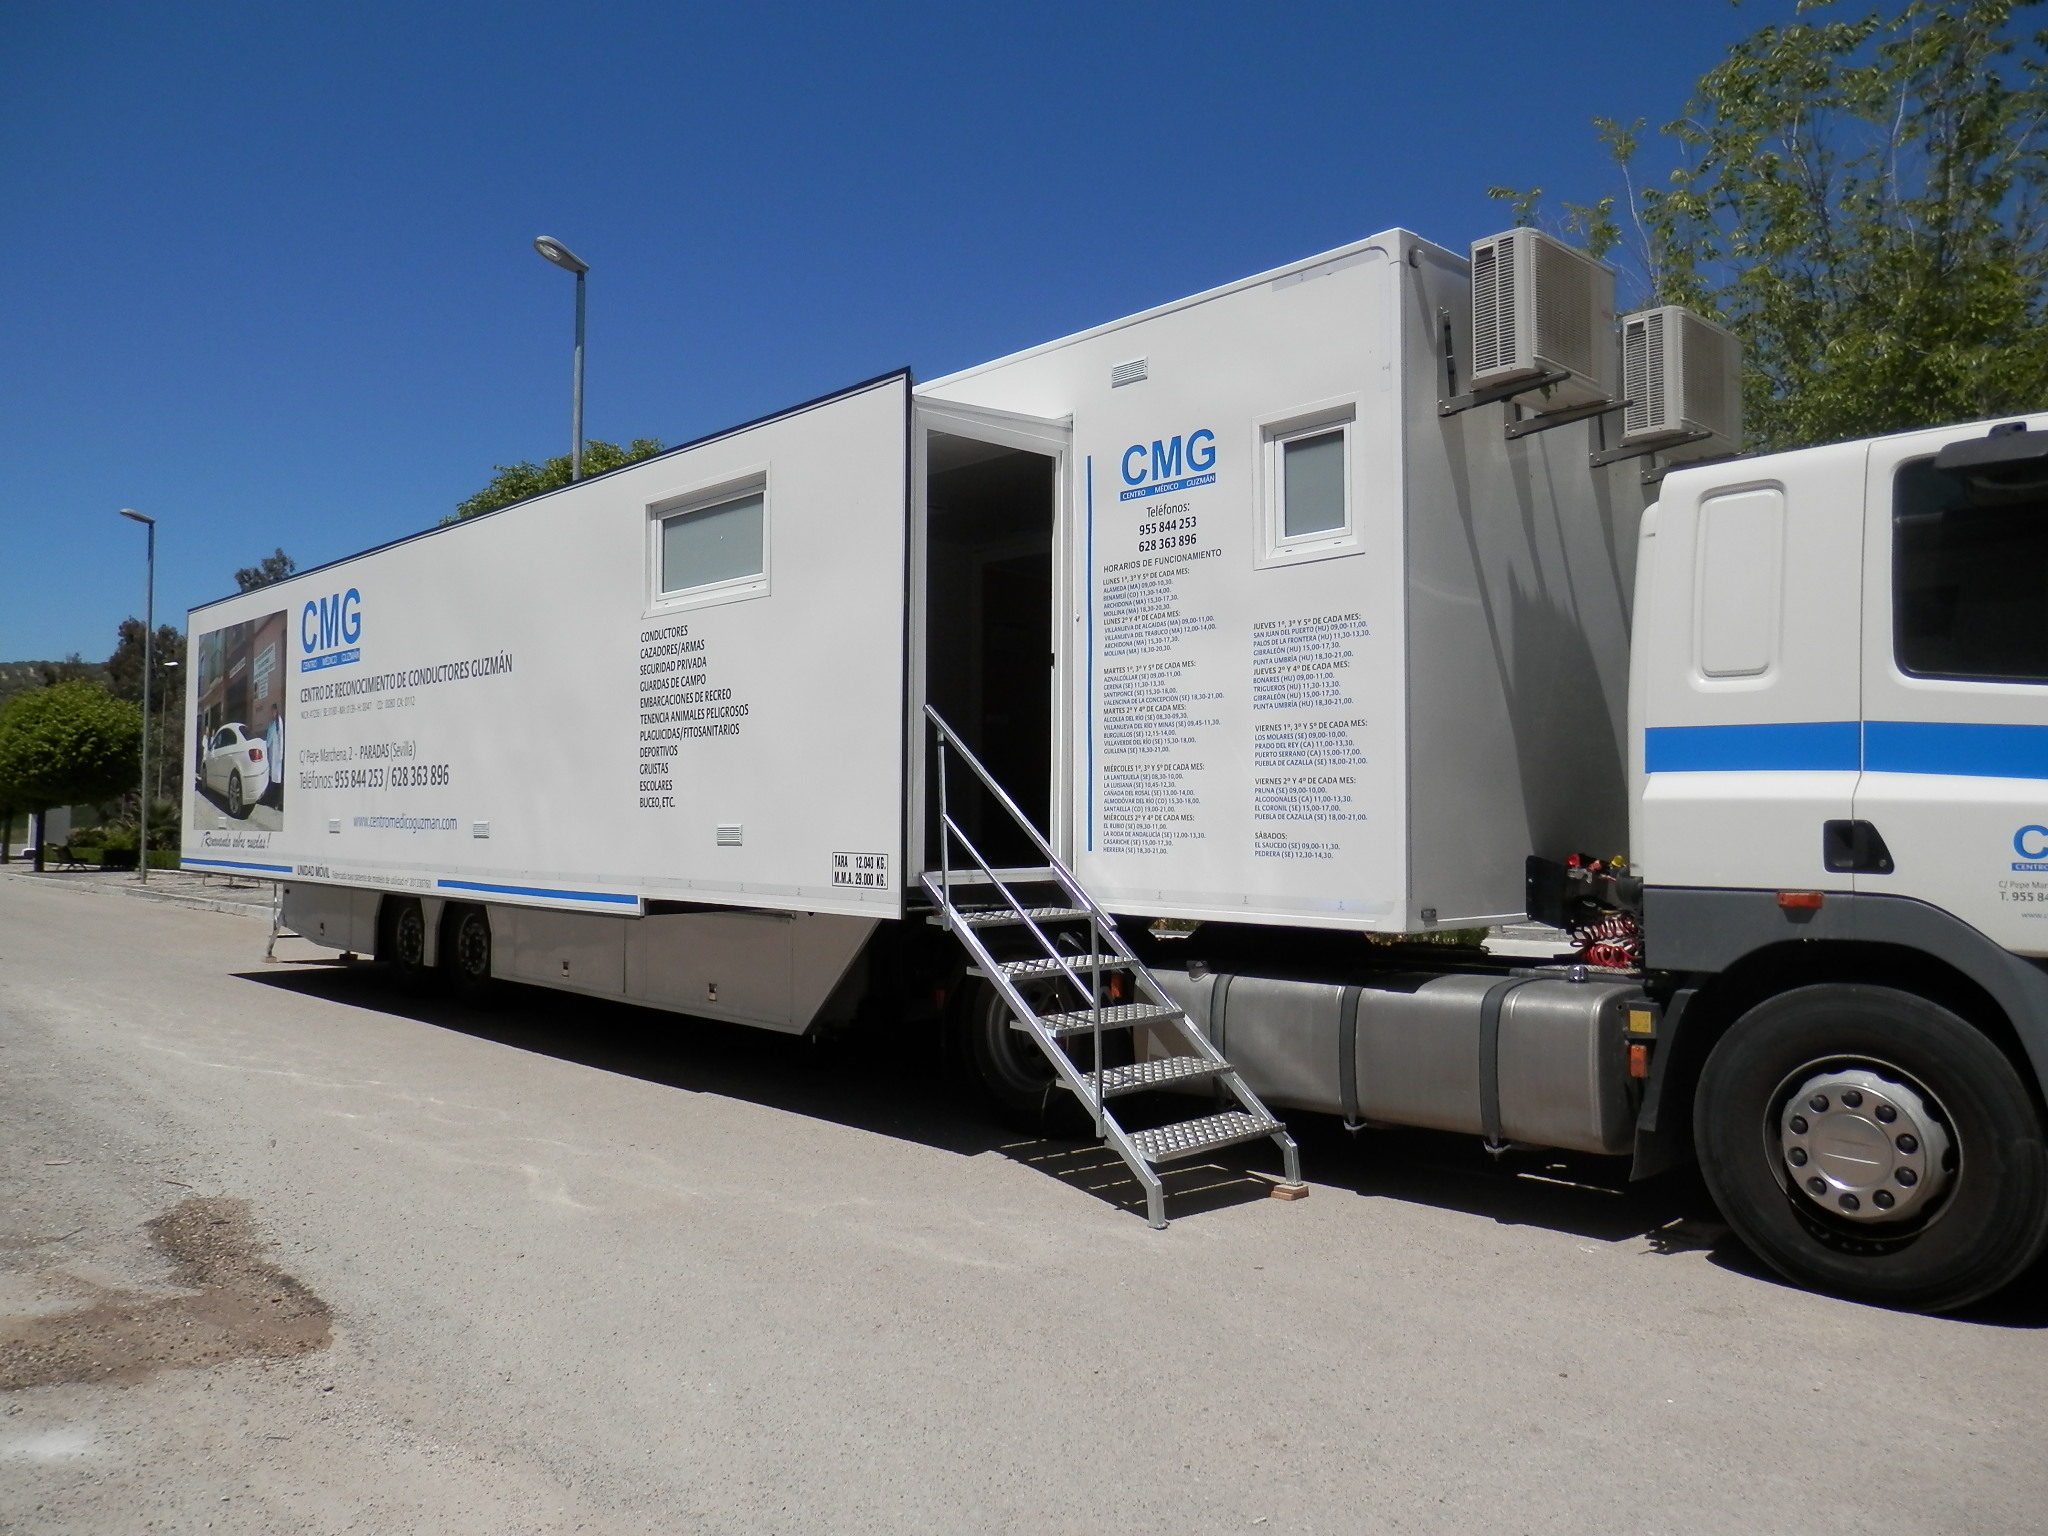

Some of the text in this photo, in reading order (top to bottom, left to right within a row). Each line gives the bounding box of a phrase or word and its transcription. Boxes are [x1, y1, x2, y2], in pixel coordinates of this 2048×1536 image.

[1122, 429, 1216, 485] CMG
[1123, 475, 1214, 499] CENTRO MÉDICO GUZMÁN
[1147, 503, 1190, 517] Teléfonos:
[1140, 516, 1196, 535] 955 844 253
[1139, 534, 1196, 552] 628 363 896
[1104, 549, 1221, 573] HORARIOS DE FUNCIONAMIENTO
[1104, 584, 1126, 593] ALAMEDA
[1128, 583, 1140, 591] (MA)
[302, 588, 360, 653] CMG
[1104, 609, 1125, 617] MOLLINA
[1254, 621, 1275, 630] JUEVES
[1323, 615, 1342, 623] CADA
[1292, 626, 1314, 634] PUERTO
[640, 625, 688, 642] CONDUCTORES
[1288, 635, 1316, 644] FRONTERA
[640, 639, 705, 659] CAZADORES/ARMAS
[303, 651, 360, 670] CENTRO MÉDICO GUZMÁN
[640, 657, 707, 675] SEGURIDAD PRIVADA
[301, 650, 512, 703] CENTRO DE RECONOCIMIENTO DE CONDUCTORES GUZMÁN
[640, 674, 706, 692] GUARDAS DE CAMPO
[640, 688, 731, 708] EMBARCACIONES DE RECREO
[640, 704, 749, 724] TENENCIA ANIMALES PELIGROSOS
[640, 723, 740, 741] PLAGUICIDAS/FITOSANITARIOS
[300, 750, 305, 766] C/
[306, 750, 319, 765] Pepe
[320, 747, 347, 763] Marchena,
[349, 746, 352, 760] 2
[360, 743, 389, 759] PARADAS
[390, 740, 416, 761] (Sevilla)
[640, 745, 678, 757] DEPORTIVOS
[300, 764, 449, 791] Teléfonos: 955 844 253 / 628 363 896
[640, 763, 668, 774] GRUISTAS
[640, 780, 672, 791] ESCOLARES
[640, 797, 675, 809] BUCEO, ETC.
[354, 816, 457, 834] www.centromedicoguzman.com
[1255, 831, 1287, 839] SÁBADOS:
[298, 863, 330, 878] UNIDAD MÓVIL
[835, 855, 886, 869] TARA 12.040 KG.
[834, 871, 886, 886] M.M.A. 29.000 KG.
[2000, 892, 2008, 901] T.
[2012, 892, 2033, 901] 955
